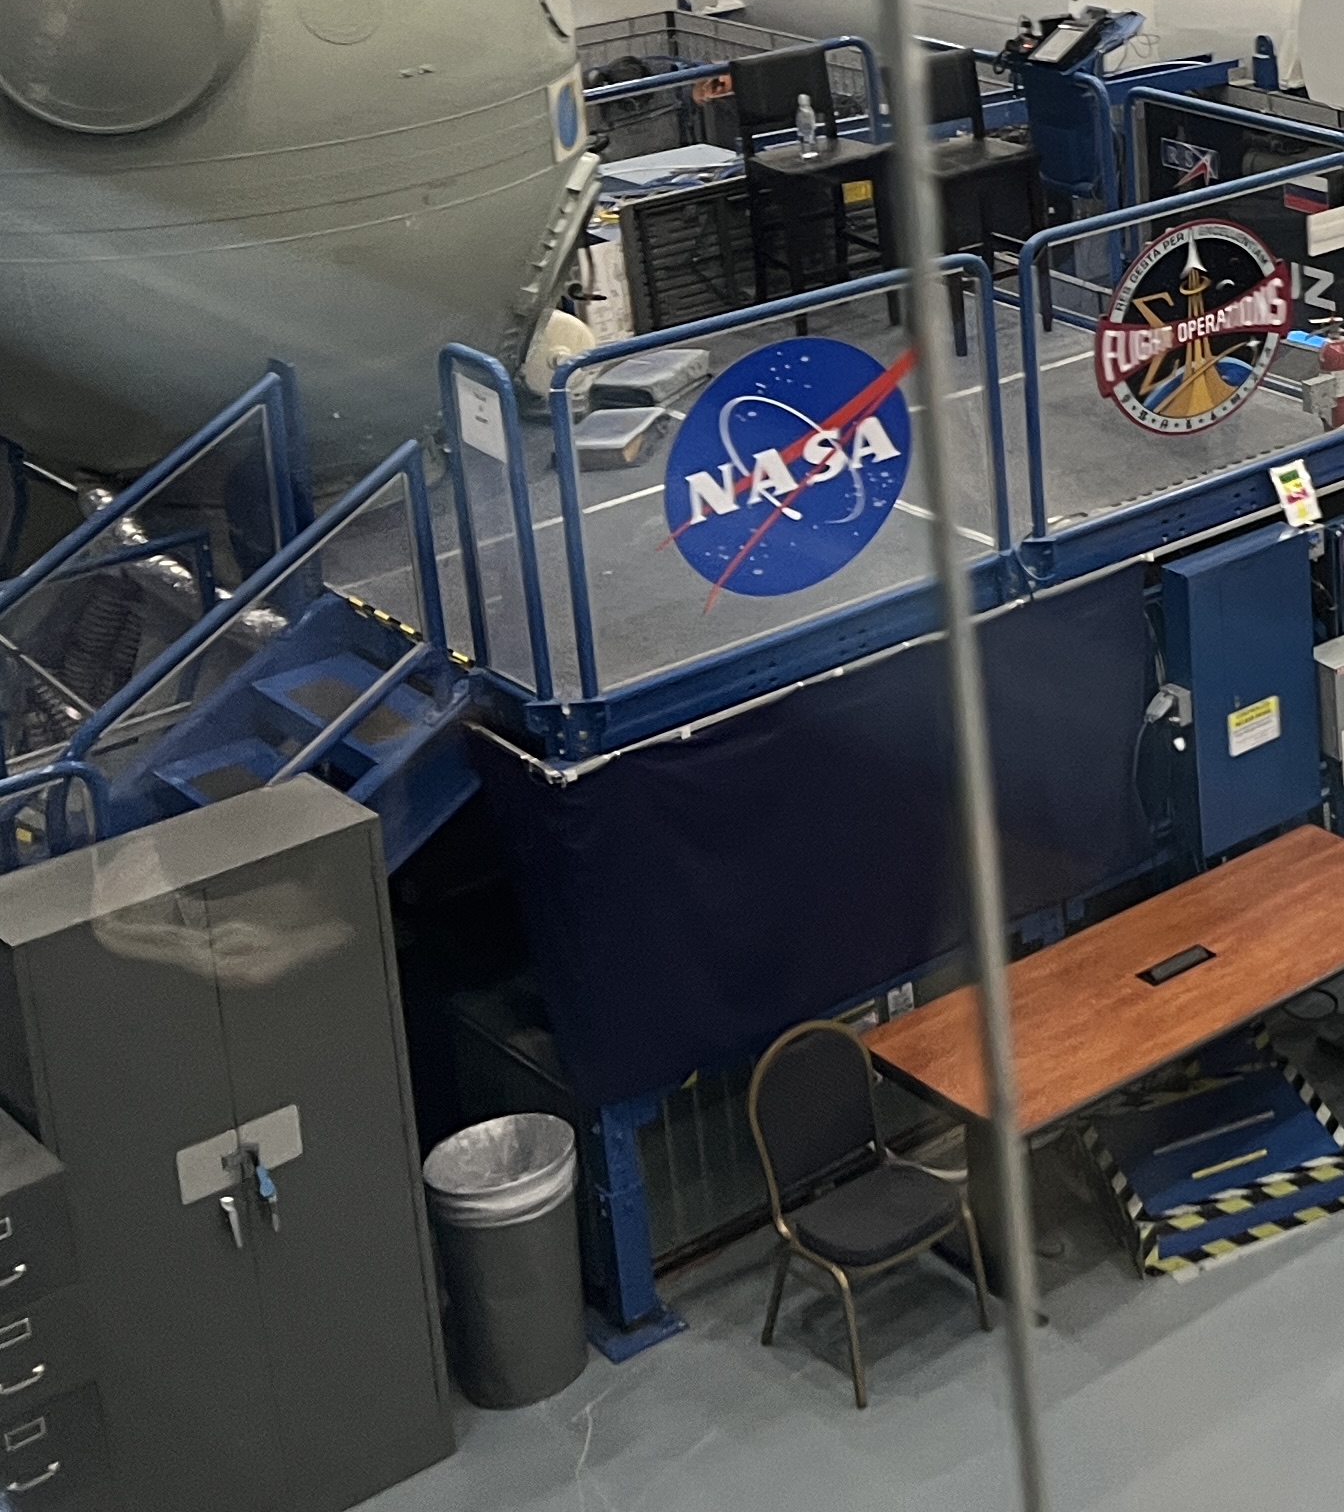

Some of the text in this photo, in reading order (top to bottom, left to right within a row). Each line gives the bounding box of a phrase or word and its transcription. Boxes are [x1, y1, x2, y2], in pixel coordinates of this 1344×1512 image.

[1162, 231, 1186, 251] PER
[1102, 277, 1288, 381] FLIGHT OPERATIONS
[684, 416, 901, 525] NASA
